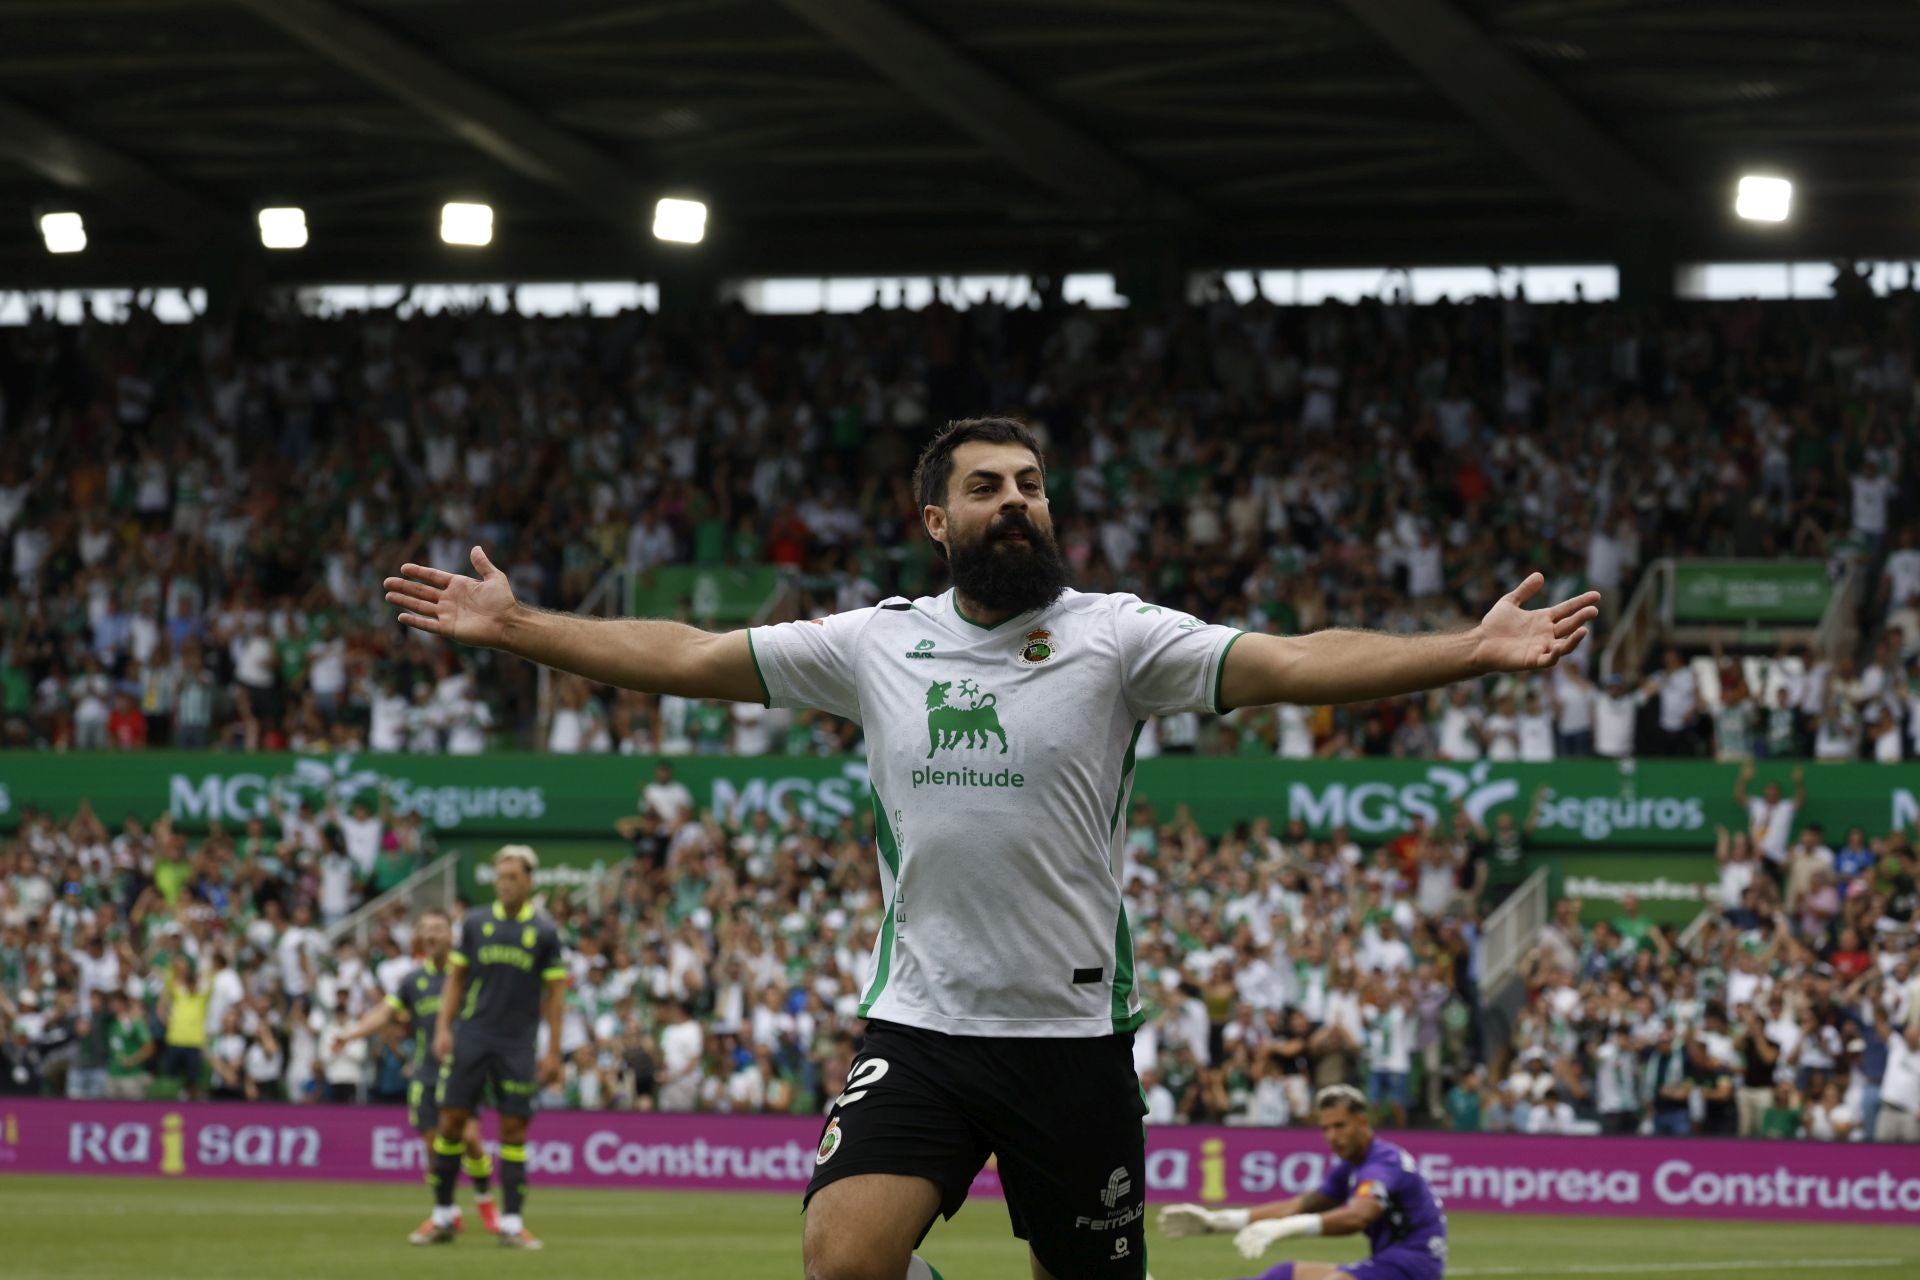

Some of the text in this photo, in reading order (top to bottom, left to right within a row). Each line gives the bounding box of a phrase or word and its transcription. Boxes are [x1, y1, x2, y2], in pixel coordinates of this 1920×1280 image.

[390, 777, 545, 828] Seguros
[912, 765, 1025, 788] plenitude
[711, 777, 855, 832] MGS
[1289, 783, 1705, 838] MGS Seguros
[1419, 1154, 1640, 1208] Empresa
[1653, 1160, 1920, 1212] Constructo
[1076, 1200, 1143, 1230] Ferroluz
